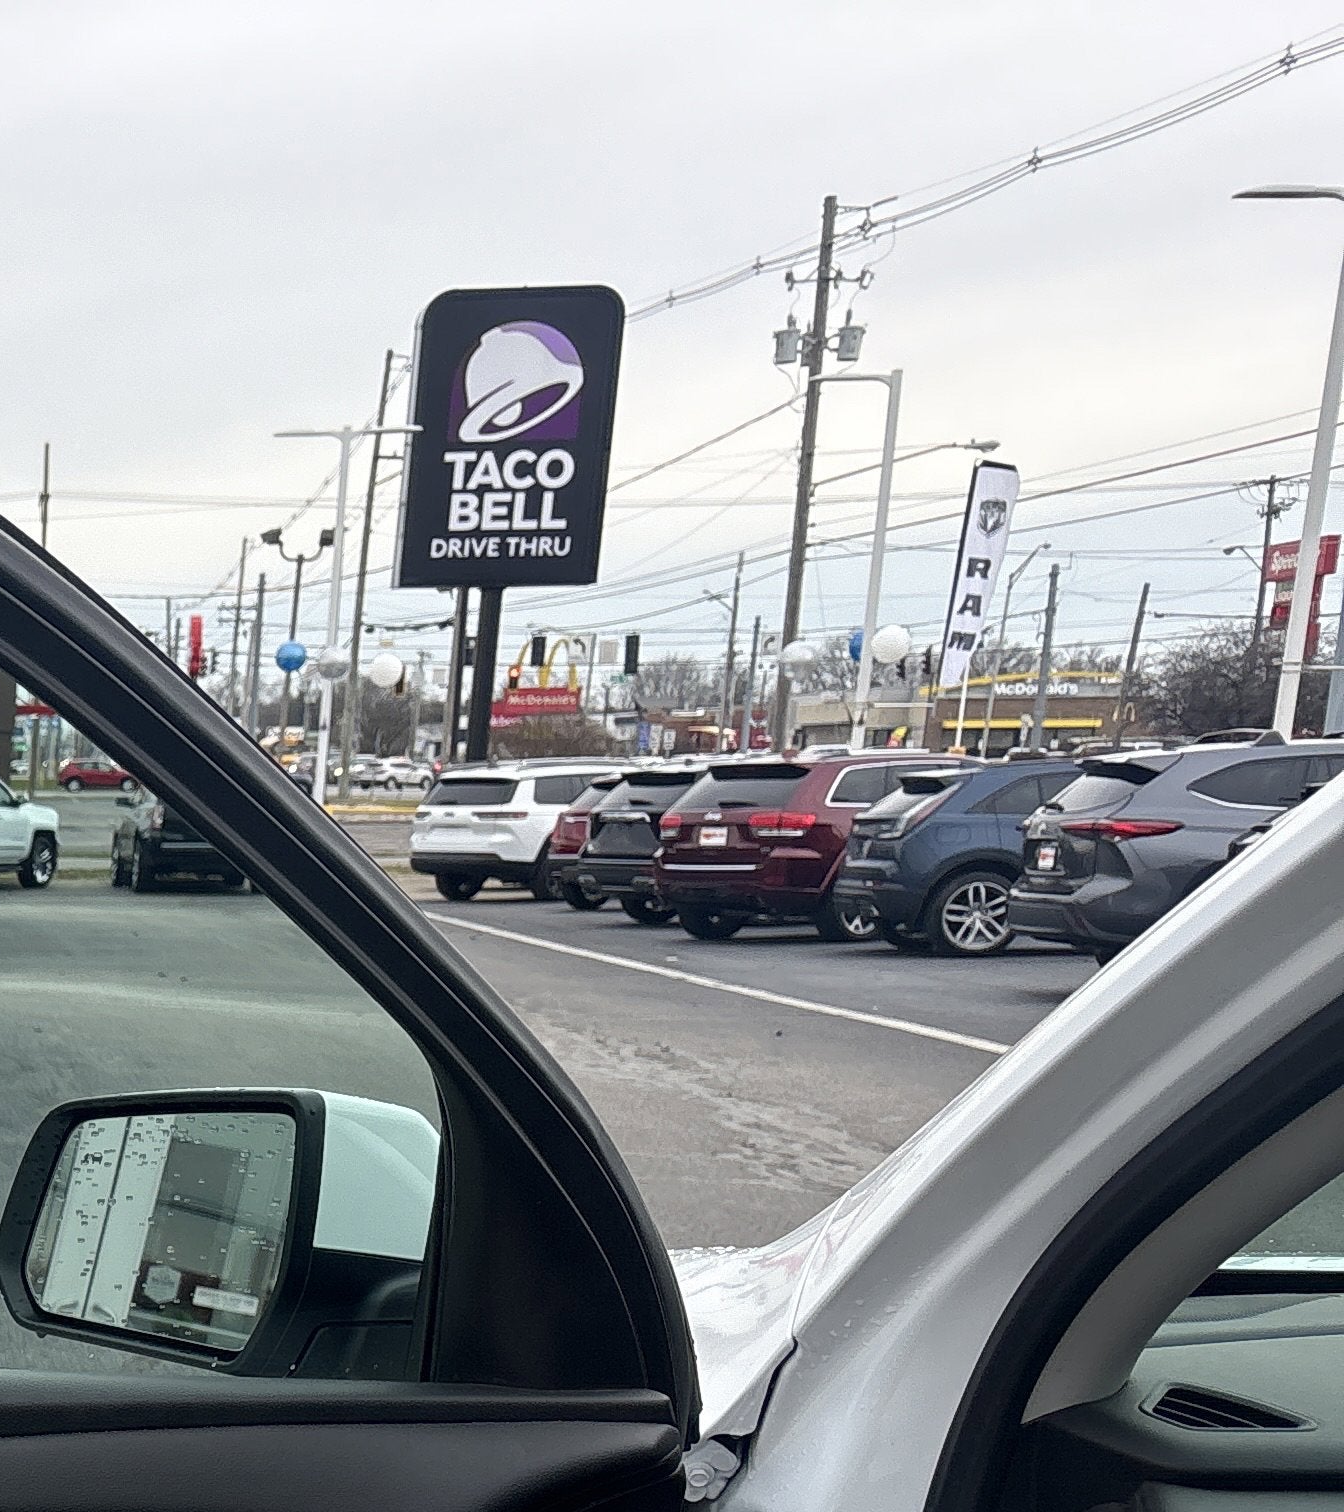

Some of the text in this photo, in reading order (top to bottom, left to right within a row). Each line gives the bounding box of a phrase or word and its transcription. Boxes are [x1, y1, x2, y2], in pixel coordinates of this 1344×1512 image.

[443, 449, 576, 491] TACO
[447, 490, 568, 532] BELL
[429, 535, 573, 559] DRIVE THRU
[993, 682, 1079, 697] McDoald's
